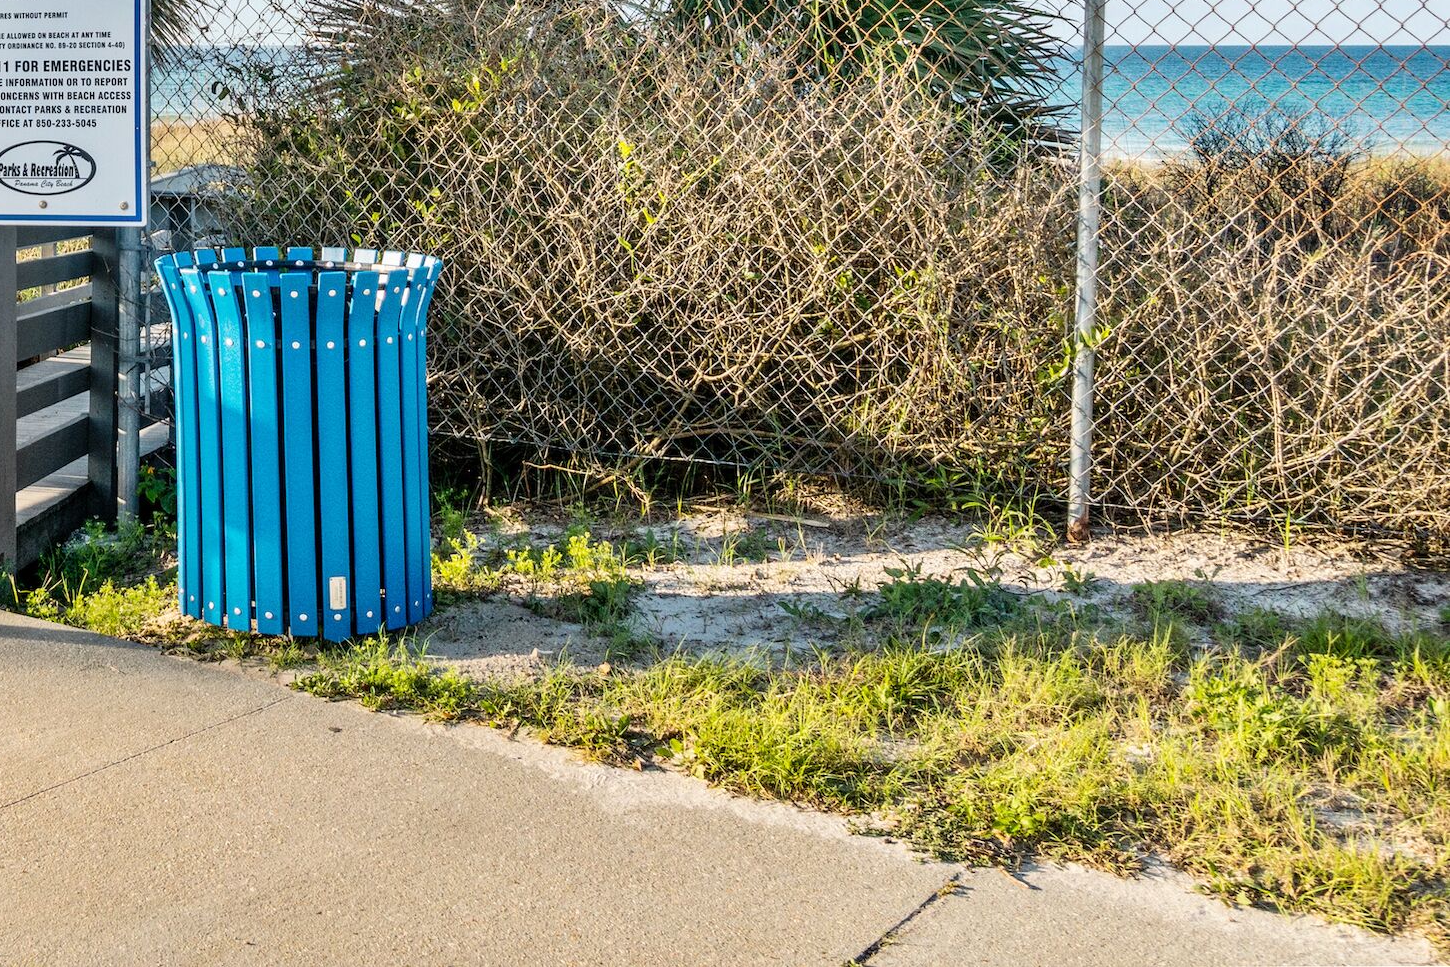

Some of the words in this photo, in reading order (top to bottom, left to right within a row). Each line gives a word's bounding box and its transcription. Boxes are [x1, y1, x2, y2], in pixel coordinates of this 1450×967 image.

[15, 61, 38, 72] FOR
[43, 60, 132, 72] EMERGENCIES
[5, 78, 64, 86] INFORMATION
[66, 78, 78, 86] OR
[81, 78, 92, 86] TO
[94, 78, 129, 86] REPORT
[42, 92, 64, 100] WITH
[67, 92, 95, 100] BEACH
[98, 92, 132, 100] ACCESS
[34, 106, 62, 114] PARKS
[74, 105, 128, 113] RECREATION
[23, 119, 33, 127] AT
[36, 119, 98, 127] 850-233-5045
[22, 163, 28, 177] &
[30, 163, 75, 177] Recreation
[55, 179, 74, 187] Beach
